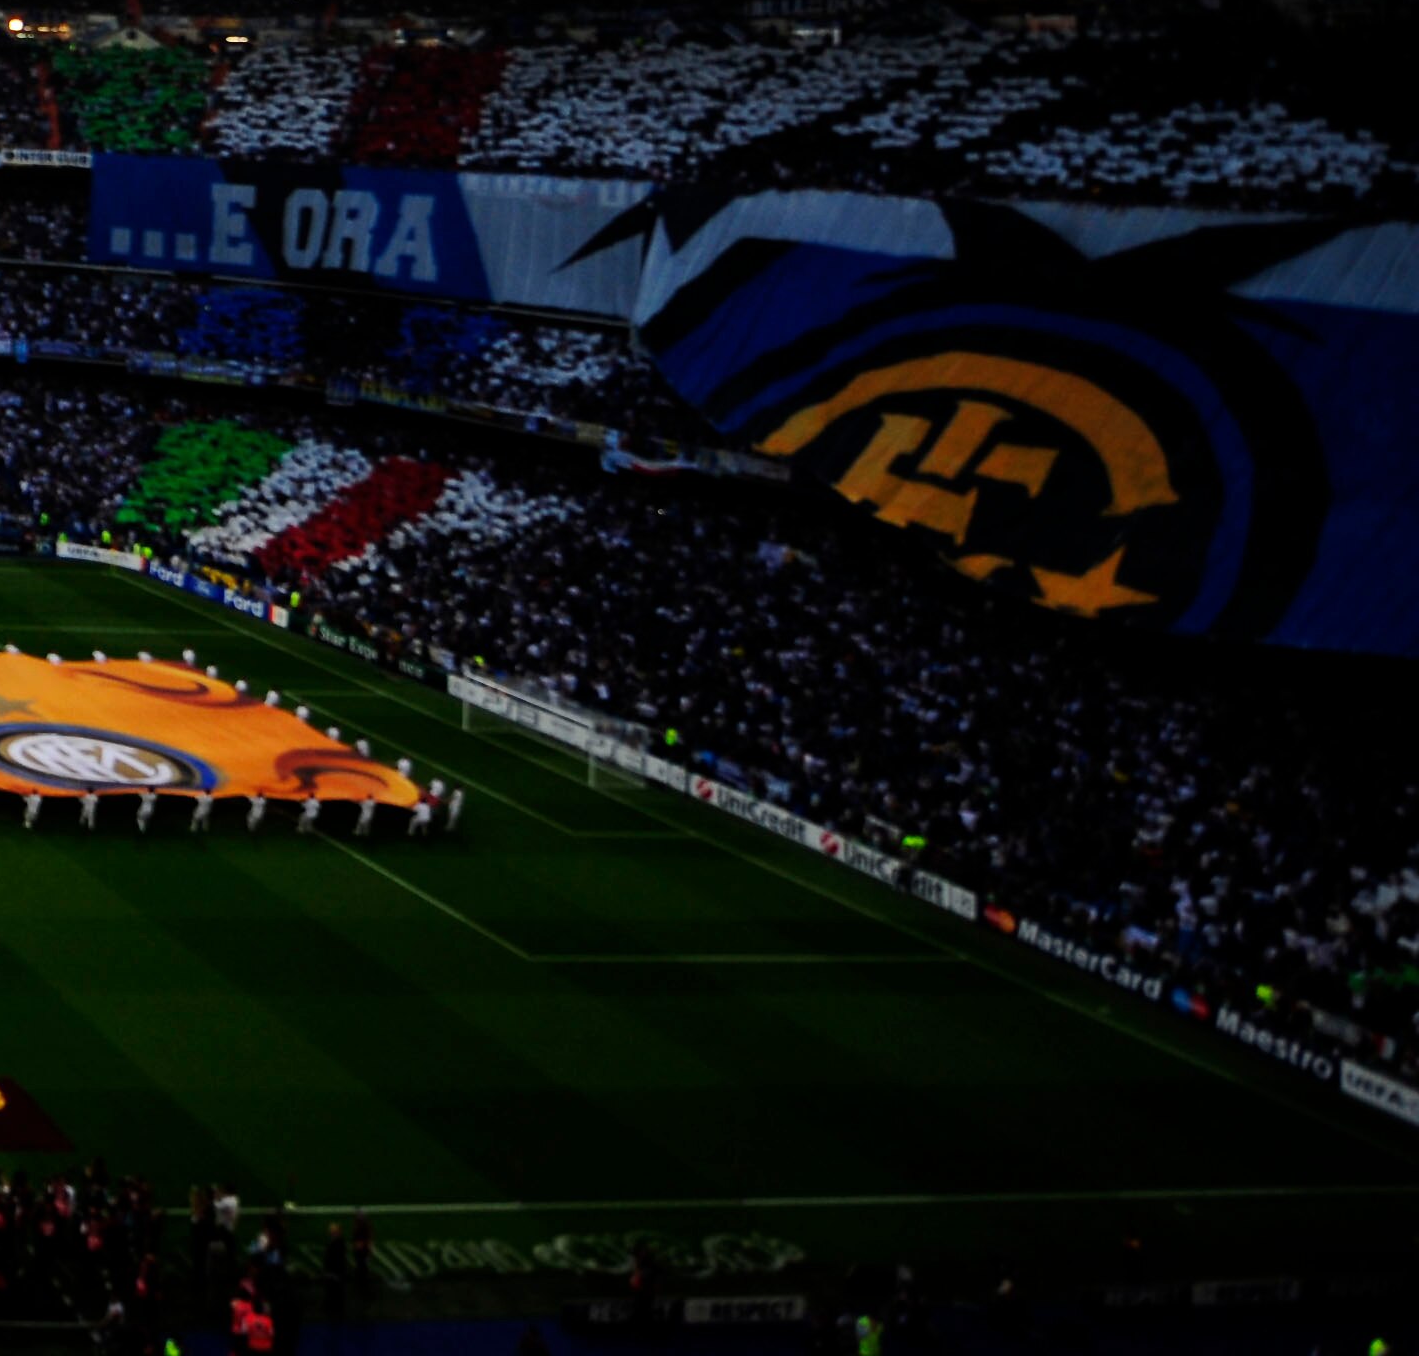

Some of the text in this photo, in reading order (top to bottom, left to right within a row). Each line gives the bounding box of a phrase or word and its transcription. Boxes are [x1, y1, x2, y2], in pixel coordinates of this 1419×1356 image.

[280, 187, 440, 284] ORA
[717, 789, 807, 839] UniCredit
[1017, 917, 1164, 1003] MasterCard
[1214, 1000, 1335, 1083] Maestro
